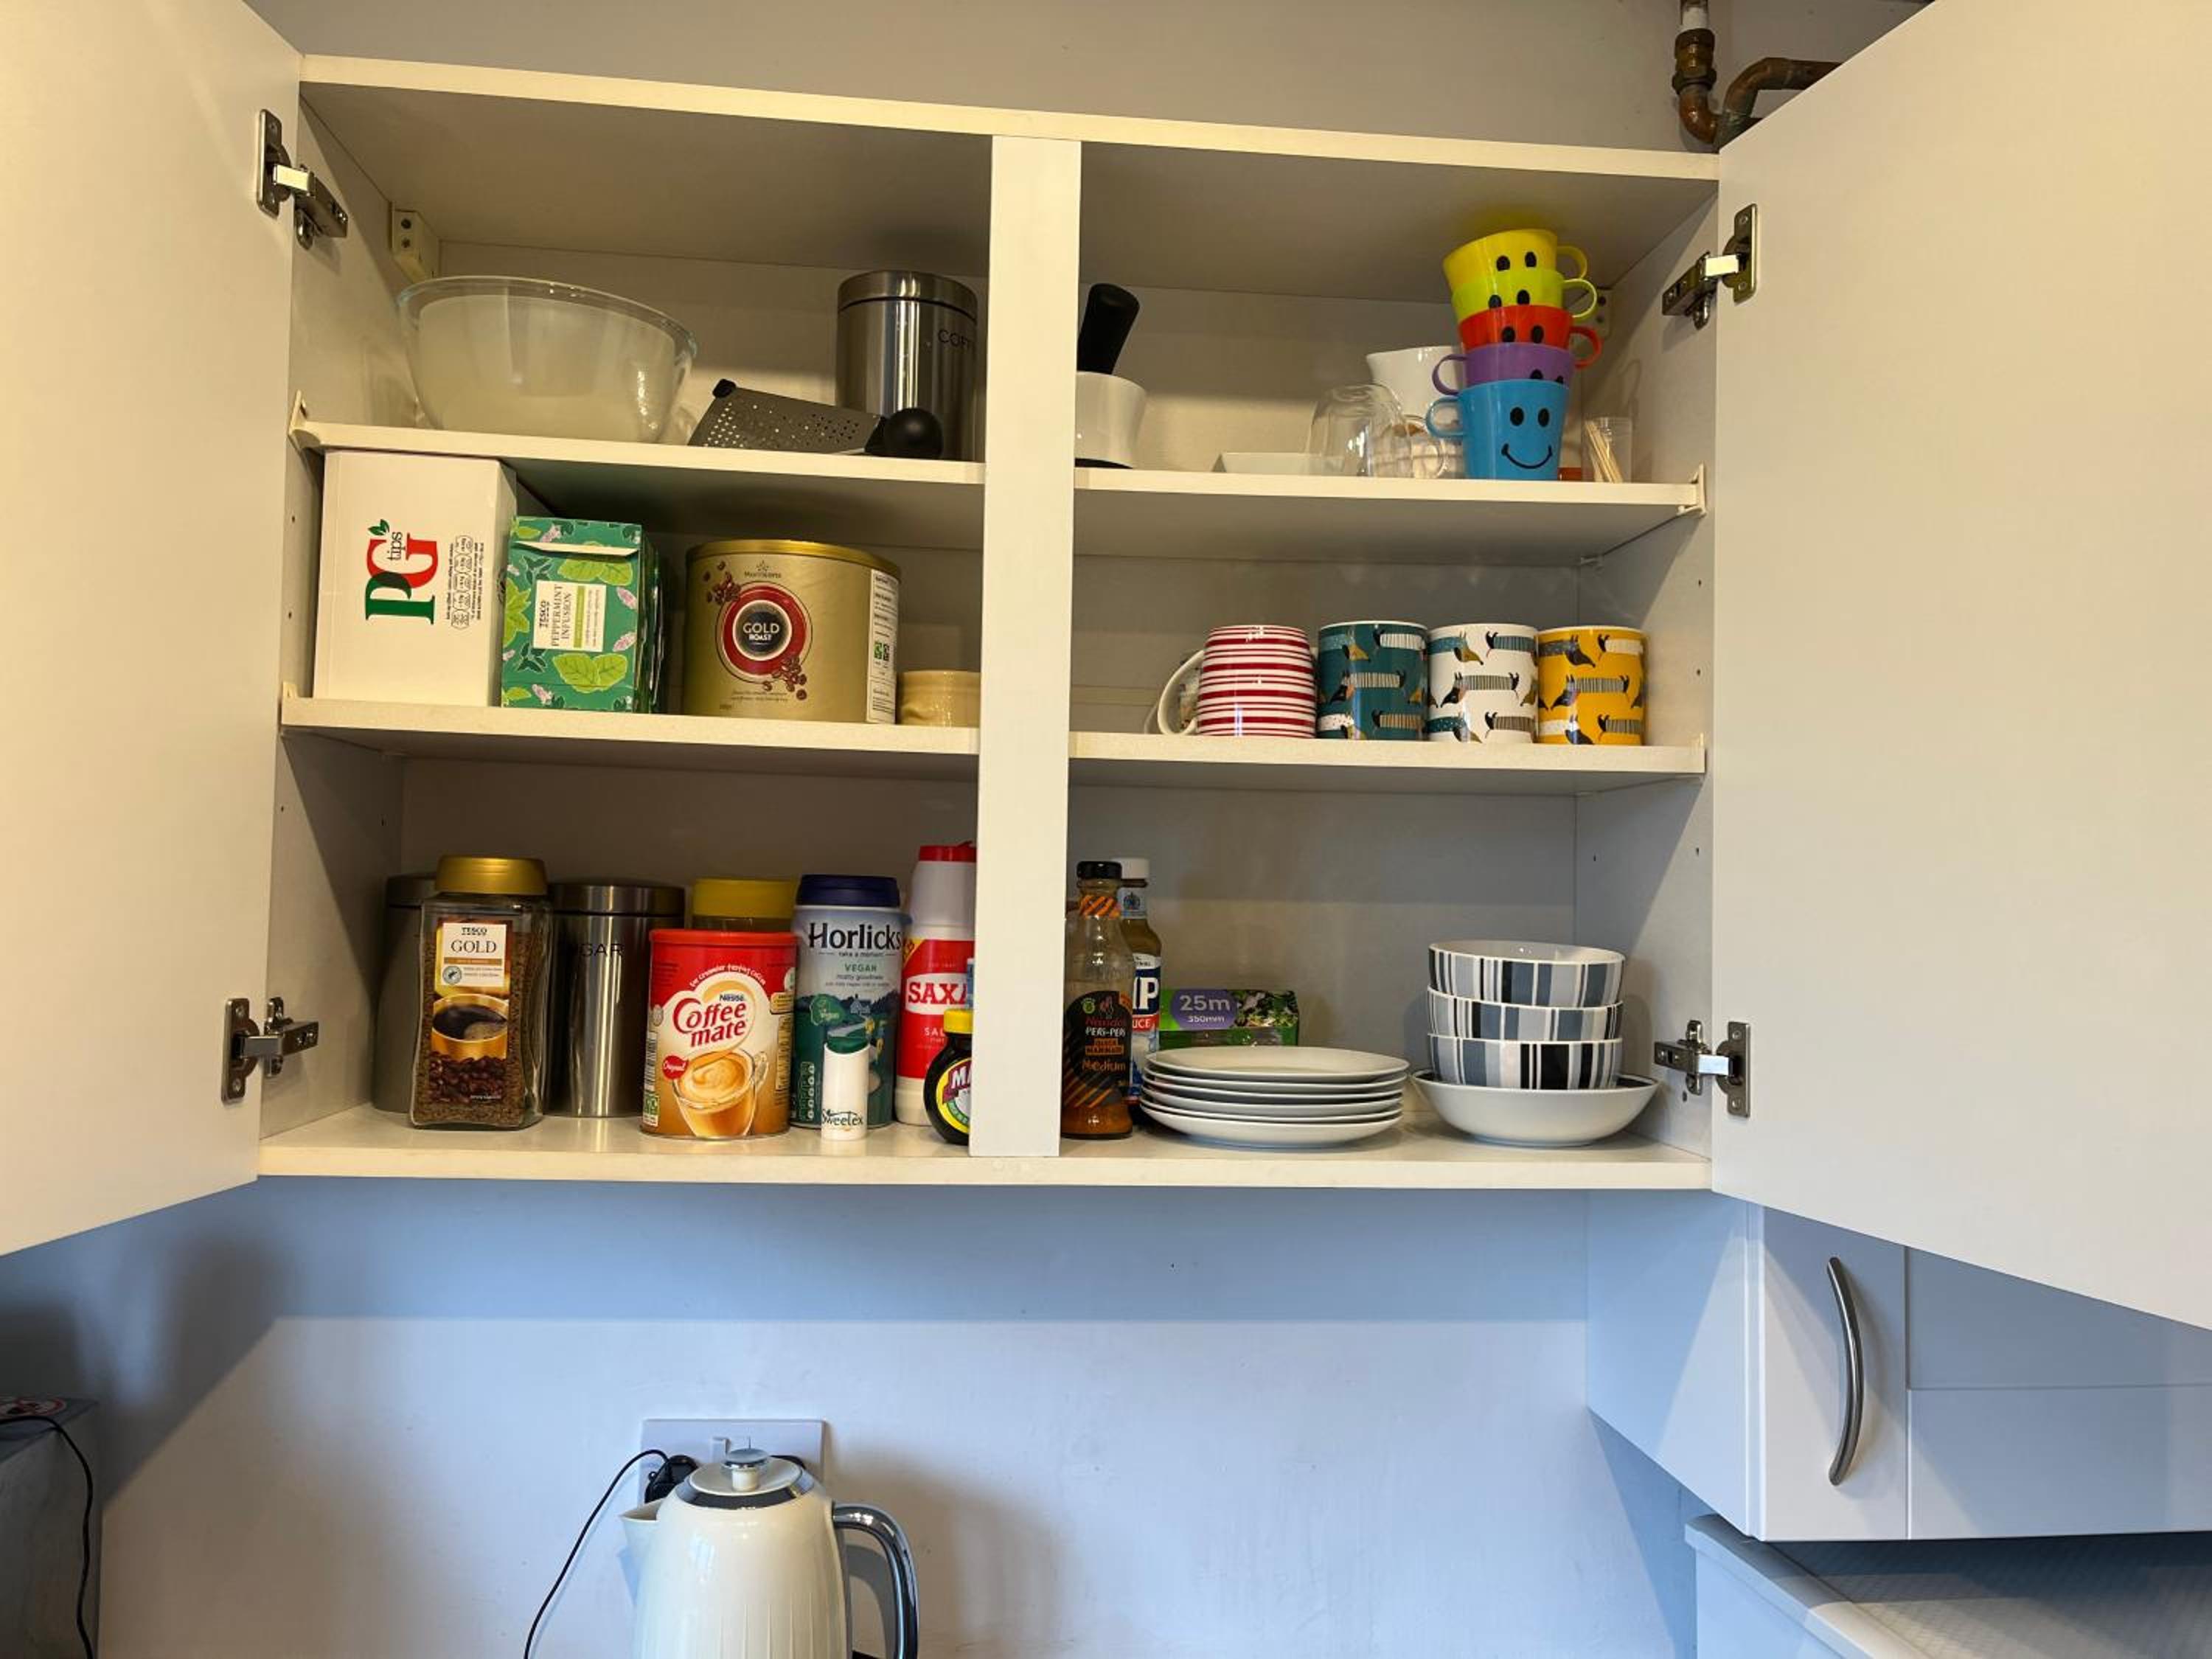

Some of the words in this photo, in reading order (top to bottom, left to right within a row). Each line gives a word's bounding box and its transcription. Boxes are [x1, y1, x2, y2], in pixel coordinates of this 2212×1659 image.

[386, 531, 406, 561] tips
[365, 532, 442, 625] PG
[539, 599, 547, 628] TESCO
[550, 582, 563, 647] PEPPERMINT
[560, 593, 572, 640] INFUSION
[742, 622, 780, 634] GOLD
[461, 927, 487, 936] TESCO
[808, 922, 901, 950] Horlicks
[451, 939, 497, 953] GOLD
[844, 963, 877, 972] VEGAN
[672, 998, 747, 1034] Coffee
[1180, 995, 1231, 1011] 25m
[690, 1019, 747, 1048] mate
[924, 1027, 946, 1037] SAL
